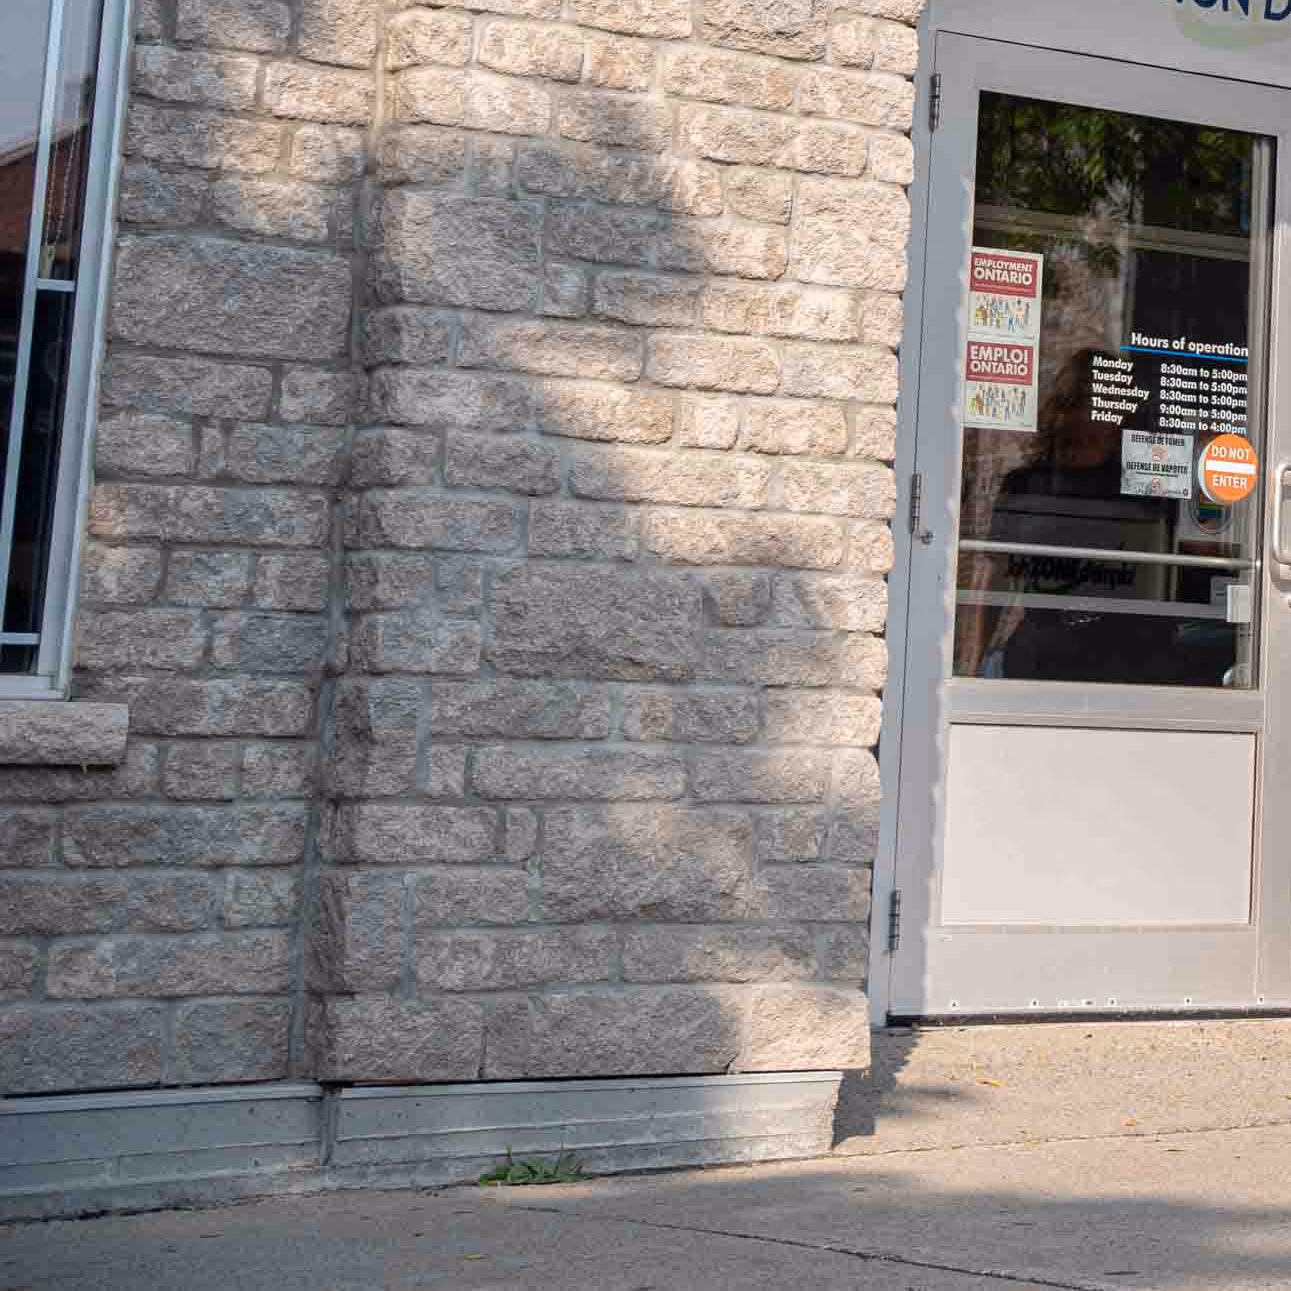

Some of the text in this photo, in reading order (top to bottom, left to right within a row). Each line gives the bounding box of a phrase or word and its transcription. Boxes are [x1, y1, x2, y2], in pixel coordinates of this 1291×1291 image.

[975, 257, 1033, 272] EMPLOYMENT
[975, 267, 1033, 286] ONTARIO
[970, 345, 1028, 364] EMPLOI
[1131, 331, 1249, 359] Hours of operation
[970, 360, 1028, 376] ONTARIO
[1092, 355, 1248, 383] Monday 8:30am to 5:00pm
[1092, 369, 1248, 396] Tuesday 8:30am to 5:00pm
[1092, 382, 1248, 408] Wednesday 8:30am to 5:00pm
[1091, 397, 1247, 423] Thursday 9:00am to 5:00pm
[1090, 410, 1247, 435] Friday 8:30am to 4:00pm
[1211, 445, 1249, 460] DO NOT
[1212, 474, 1248, 489] ENTER
